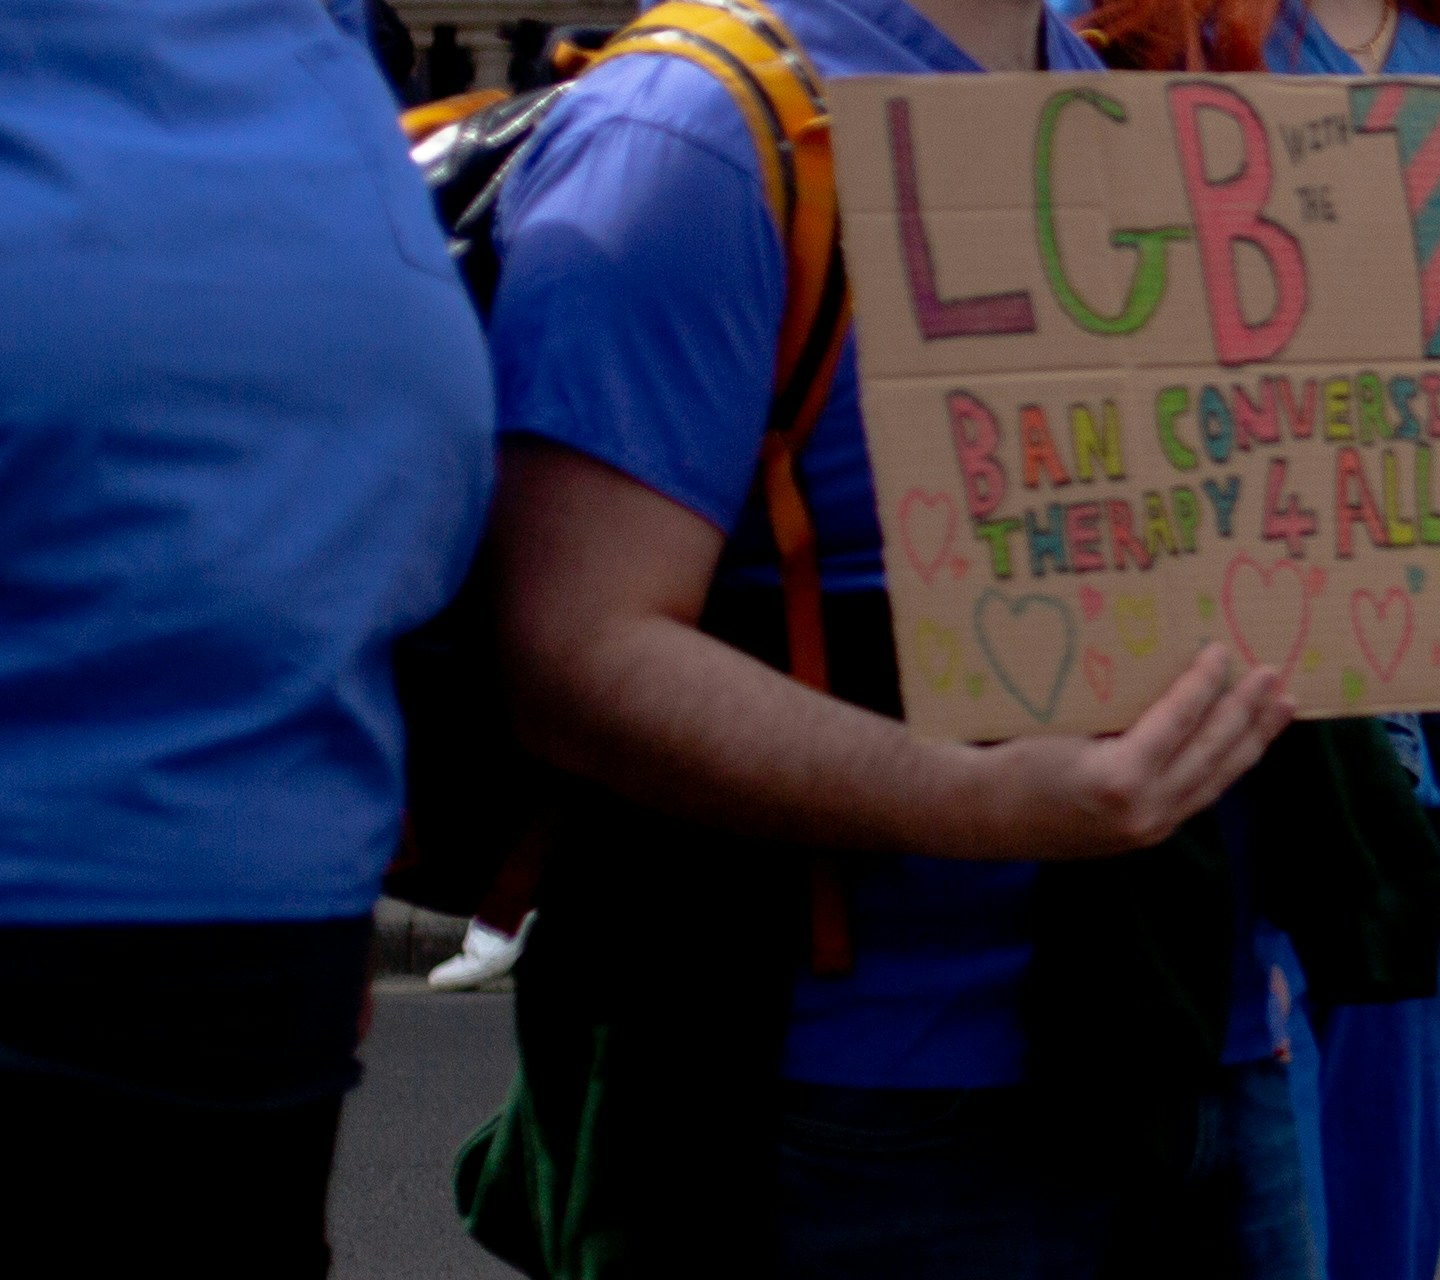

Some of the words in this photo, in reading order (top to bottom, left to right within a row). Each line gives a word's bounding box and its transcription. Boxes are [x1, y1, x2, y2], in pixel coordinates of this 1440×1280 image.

[943, 389, 1126, 522] BAN
[974, 472, 1243, 579] THERAPY
[1260, 455, 1318, 559] 4
